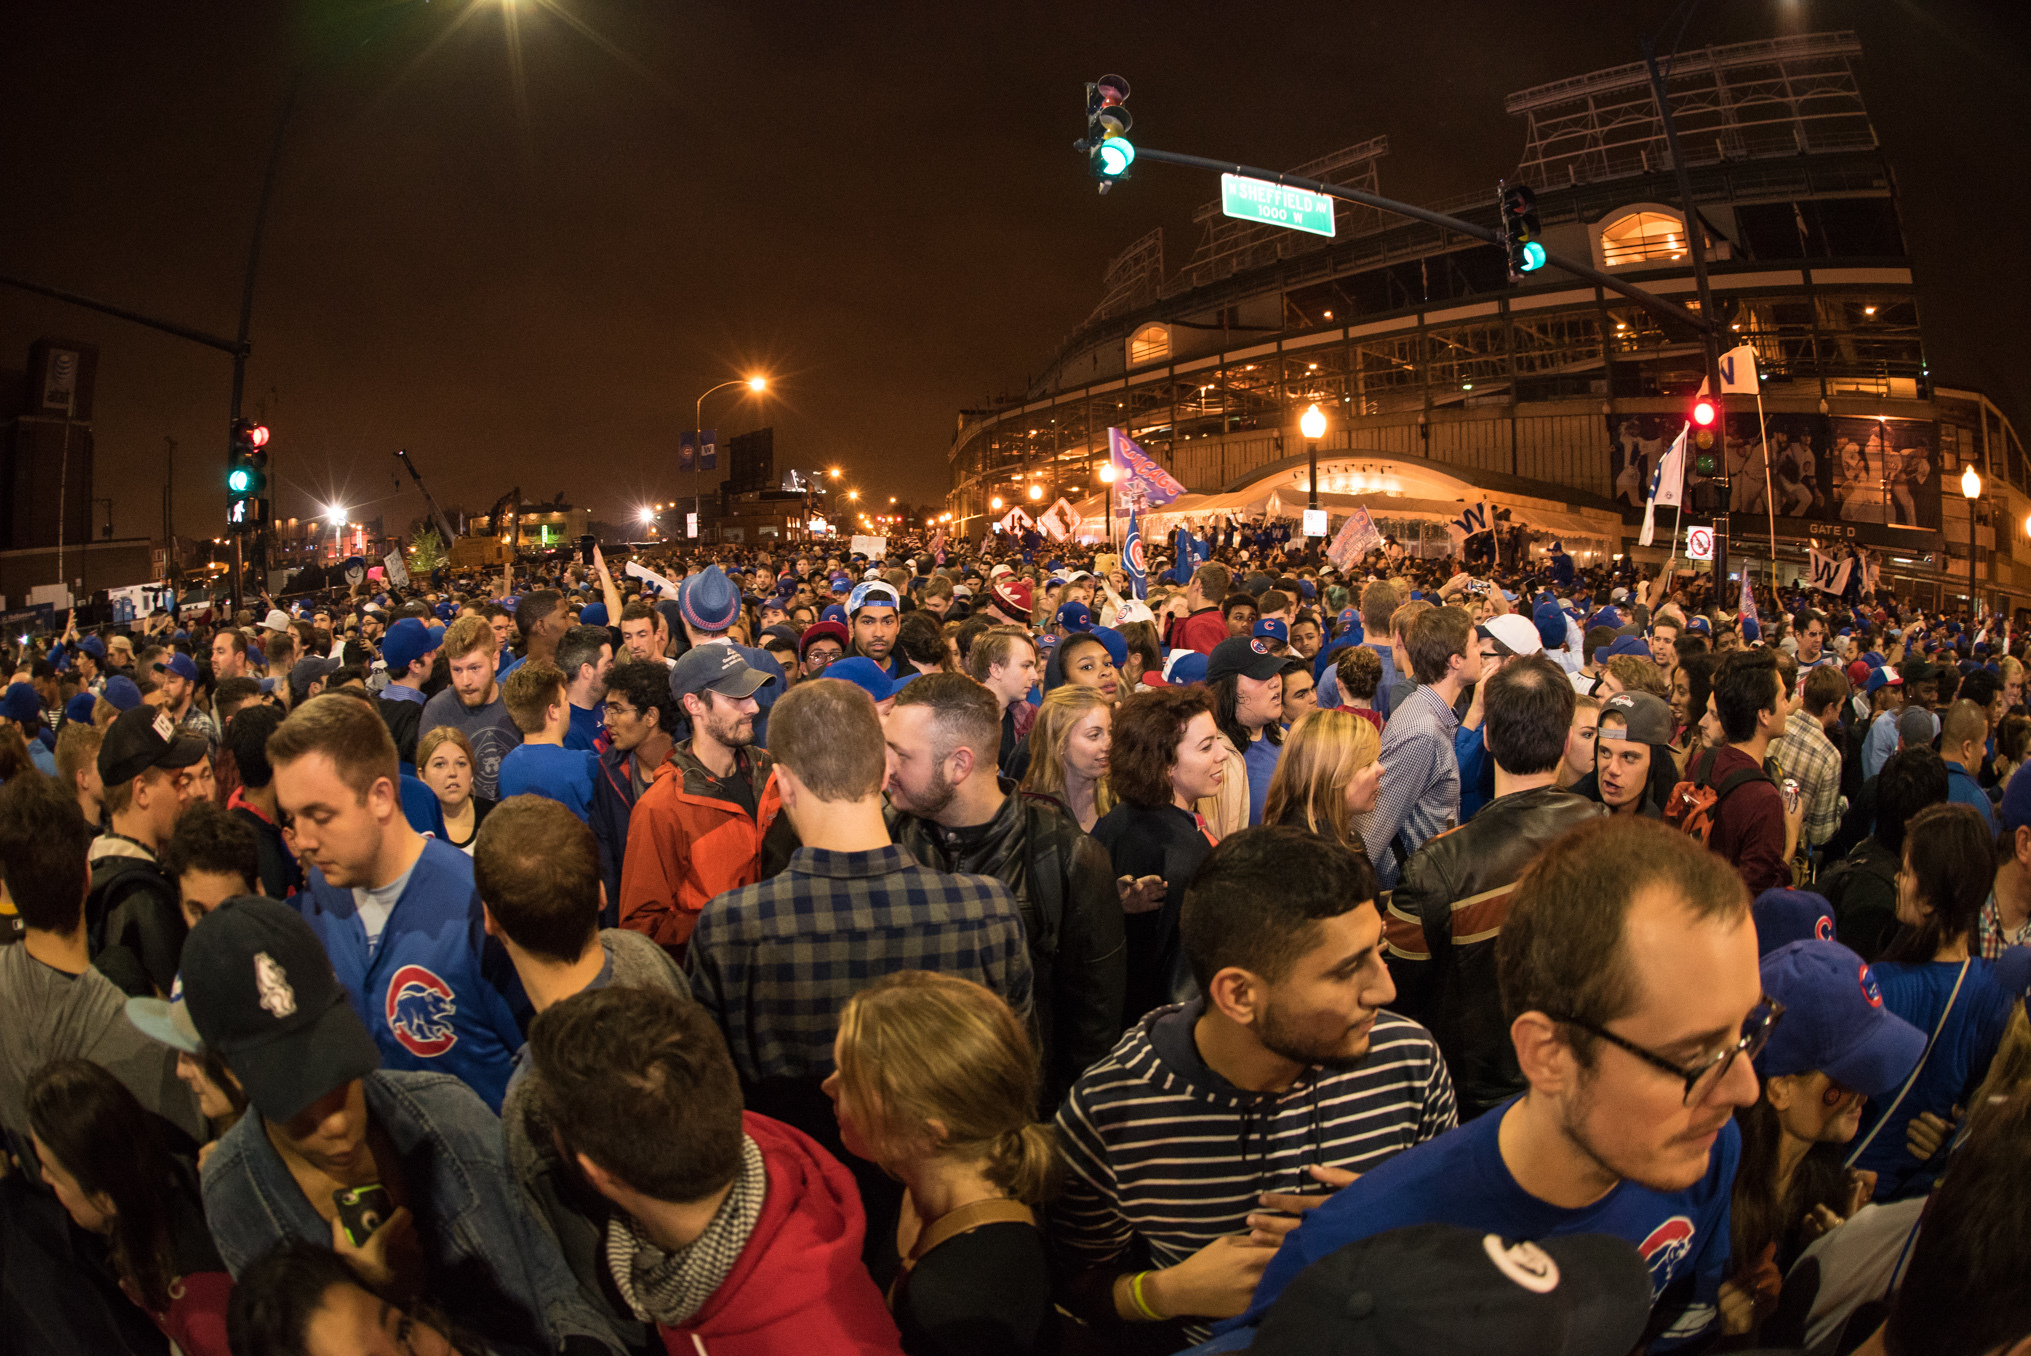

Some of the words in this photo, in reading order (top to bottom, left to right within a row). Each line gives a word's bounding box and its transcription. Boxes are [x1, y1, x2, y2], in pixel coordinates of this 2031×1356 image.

[1229, 183, 1237, 195] N
[1239, 183, 1313, 212] SHEFFIELD
[1315, 201, 1327, 214] AV
[1258, 204, 1287, 220] 1000
[1293, 211, 1303, 224] W
[1450, 502, 1487, 535] W
[1809, 523, 1842, 536] GATE
[1846, 527, 1856, 537] D
[1813, 553, 1841, 588] W
[1264, 620, 1275, 630] C
